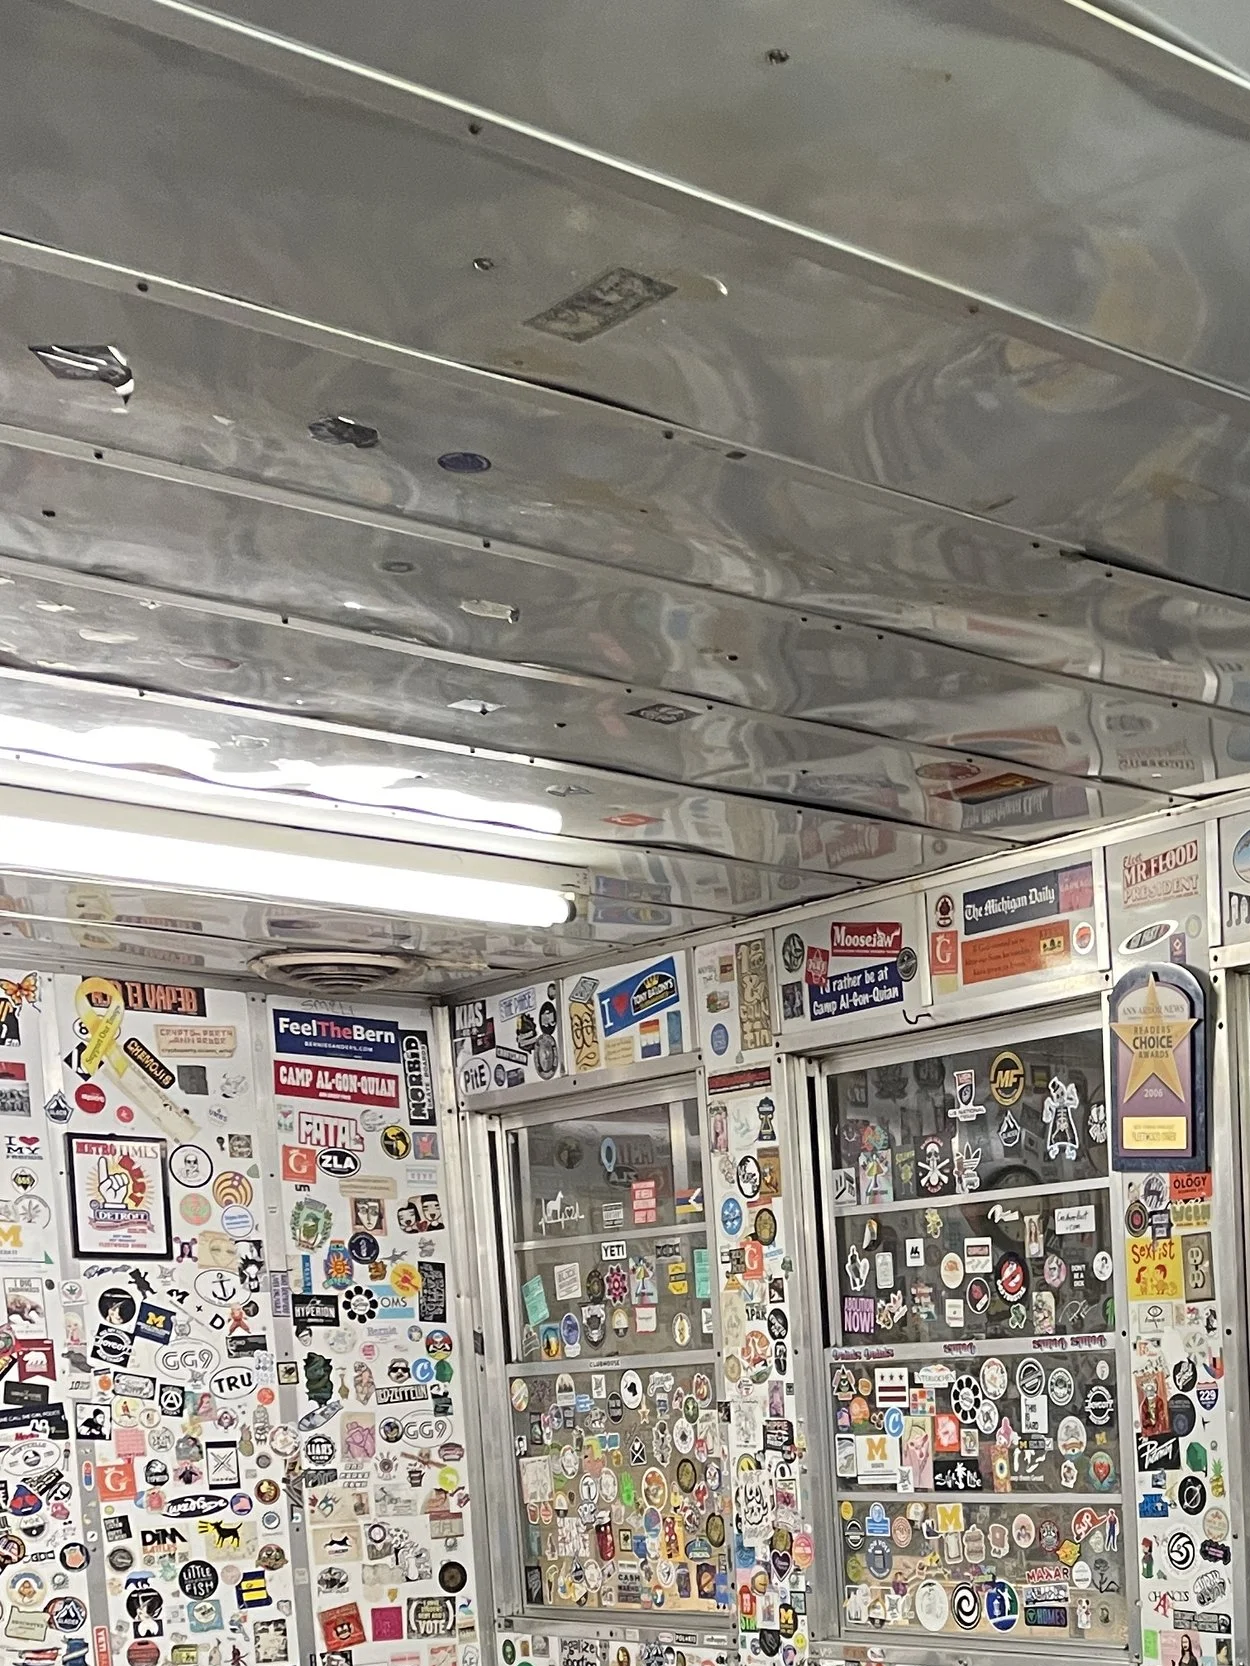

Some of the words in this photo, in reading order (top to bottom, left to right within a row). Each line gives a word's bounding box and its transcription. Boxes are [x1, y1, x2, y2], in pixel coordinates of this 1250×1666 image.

[1124, 873, 1198, 903] PRESIDENT
[965, 904, 983, 921] The
[984, 893, 1027, 917] Michigan
[1029, 883, 1056, 907] Daily
[833, 926, 898, 948] Moosejaw
[832, 972, 861, 993] rather
[864, 970, 876, 983] be
[878, 966, 888, 981] at
[813, 1000, 837, 1017] Camp
[278, 1017, 396, 1044] FeelTheBern
[1133, 1036, 1172, 1049] CHOICE
[126, 1040, 174, 1087] CHEMOJIS
[1138, 1051, 1169, 1059] AWARDS
[279, 1066, 313, 1088] CAMP
[403, 1035, 429, 1121] MORBID
[997, 1072, 1018, 1088] MF
[1144, 1088, 1163, 1098] 2006
[299, 1116, 363, 1151] FATAL
[7, 1147, 39, 1155] MY
[76, 1142, 117, 1154] METRO
[118, 1144, 158, 1159] TIMES
[320, 1155, 357, 1170] ZLA
[98, 1211, 148, 1221] DETROIT
[603, 1244, 625, 1257] YETI
[295, 1306, 336, 1319] HYPERION
[845, 1312, 875, 1334] NOW!
[214, 1373, 252, 1393] TRU
[1200, 1391, 1216, 1400] 229
[1025, 1403, 1037, 1412] THIS
[866, 1438, 888, 1461] M
[1076, 1513, 1092, 1536] SUP
[183, 1564, 213, 1580] LITTLE
[185, 1581, 215, 1597] FISH
[1035, 1608, 1067, 1625] HOMES
[418, 1620, 446, 1635] VOTE
[560, 1639, 596, 1655] legalize
